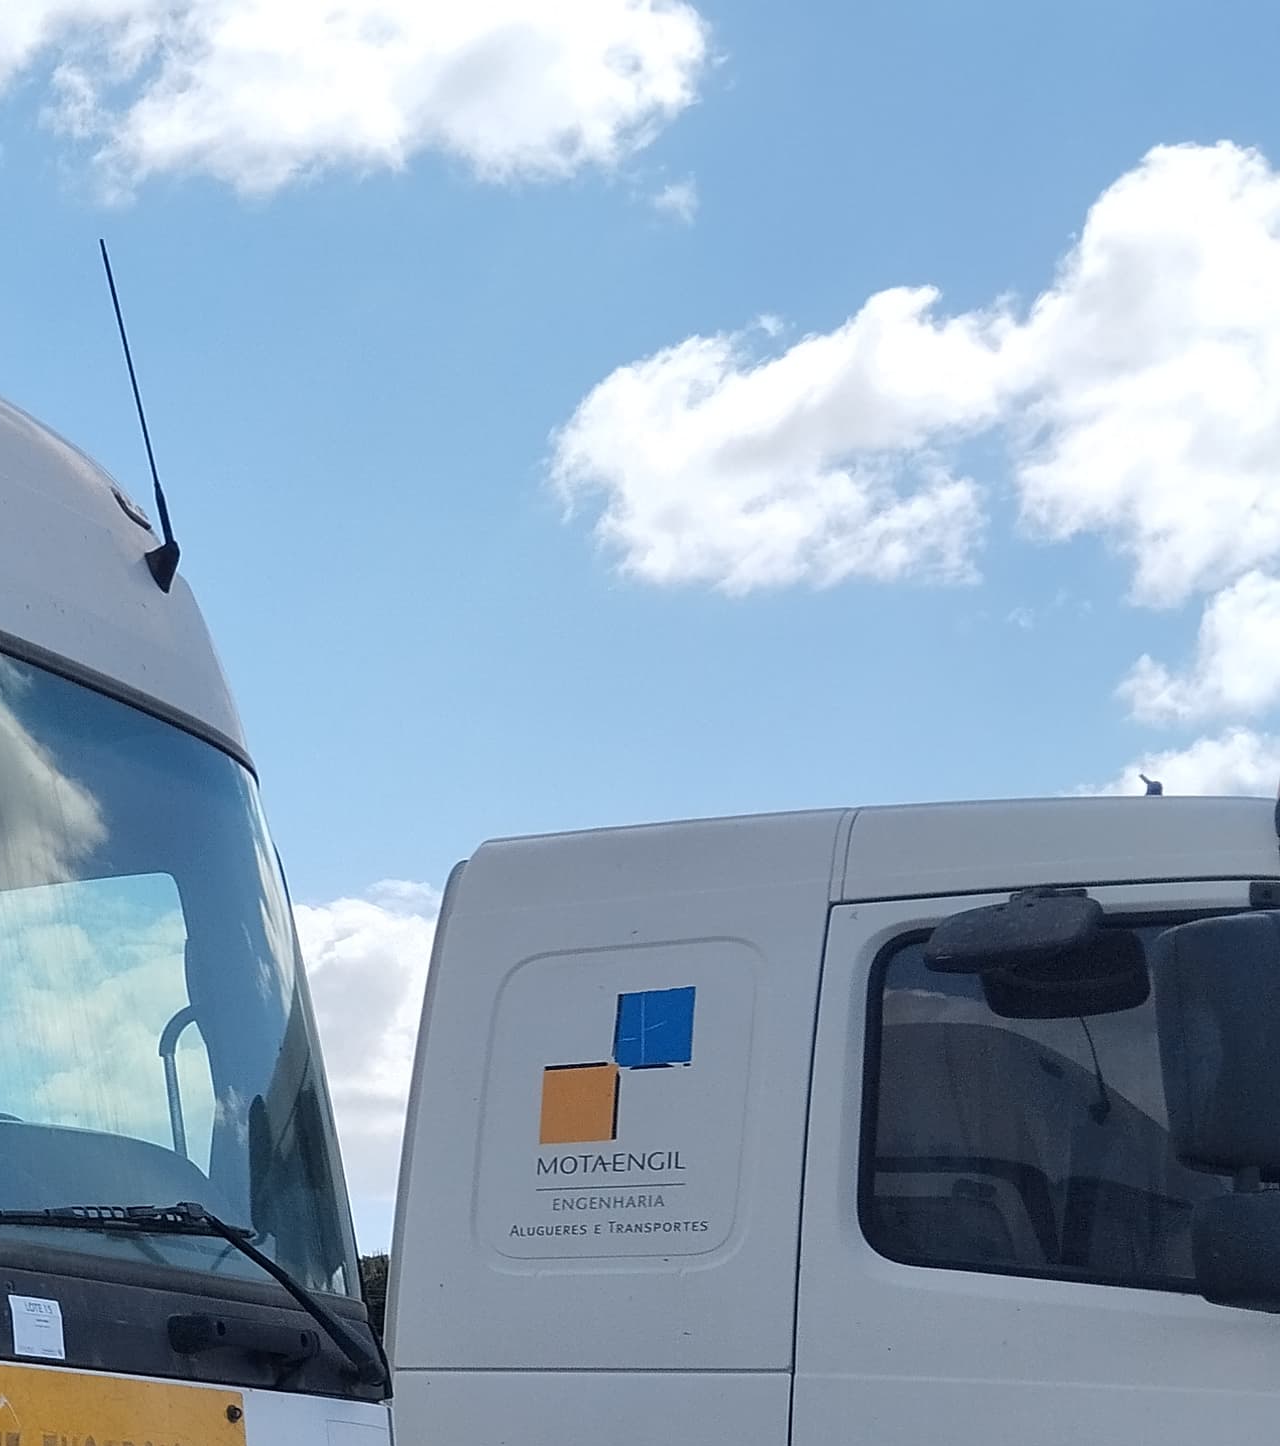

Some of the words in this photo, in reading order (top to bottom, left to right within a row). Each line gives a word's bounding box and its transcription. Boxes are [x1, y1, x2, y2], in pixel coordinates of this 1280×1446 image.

[552, 1195, 666, 1212] ENGENHARIA
[509, 1225, 588, 1237] ALUGUERES
[594, 1224, 602, 1235] E
[608, 1220, 709, 1235] TRANSPORTES
